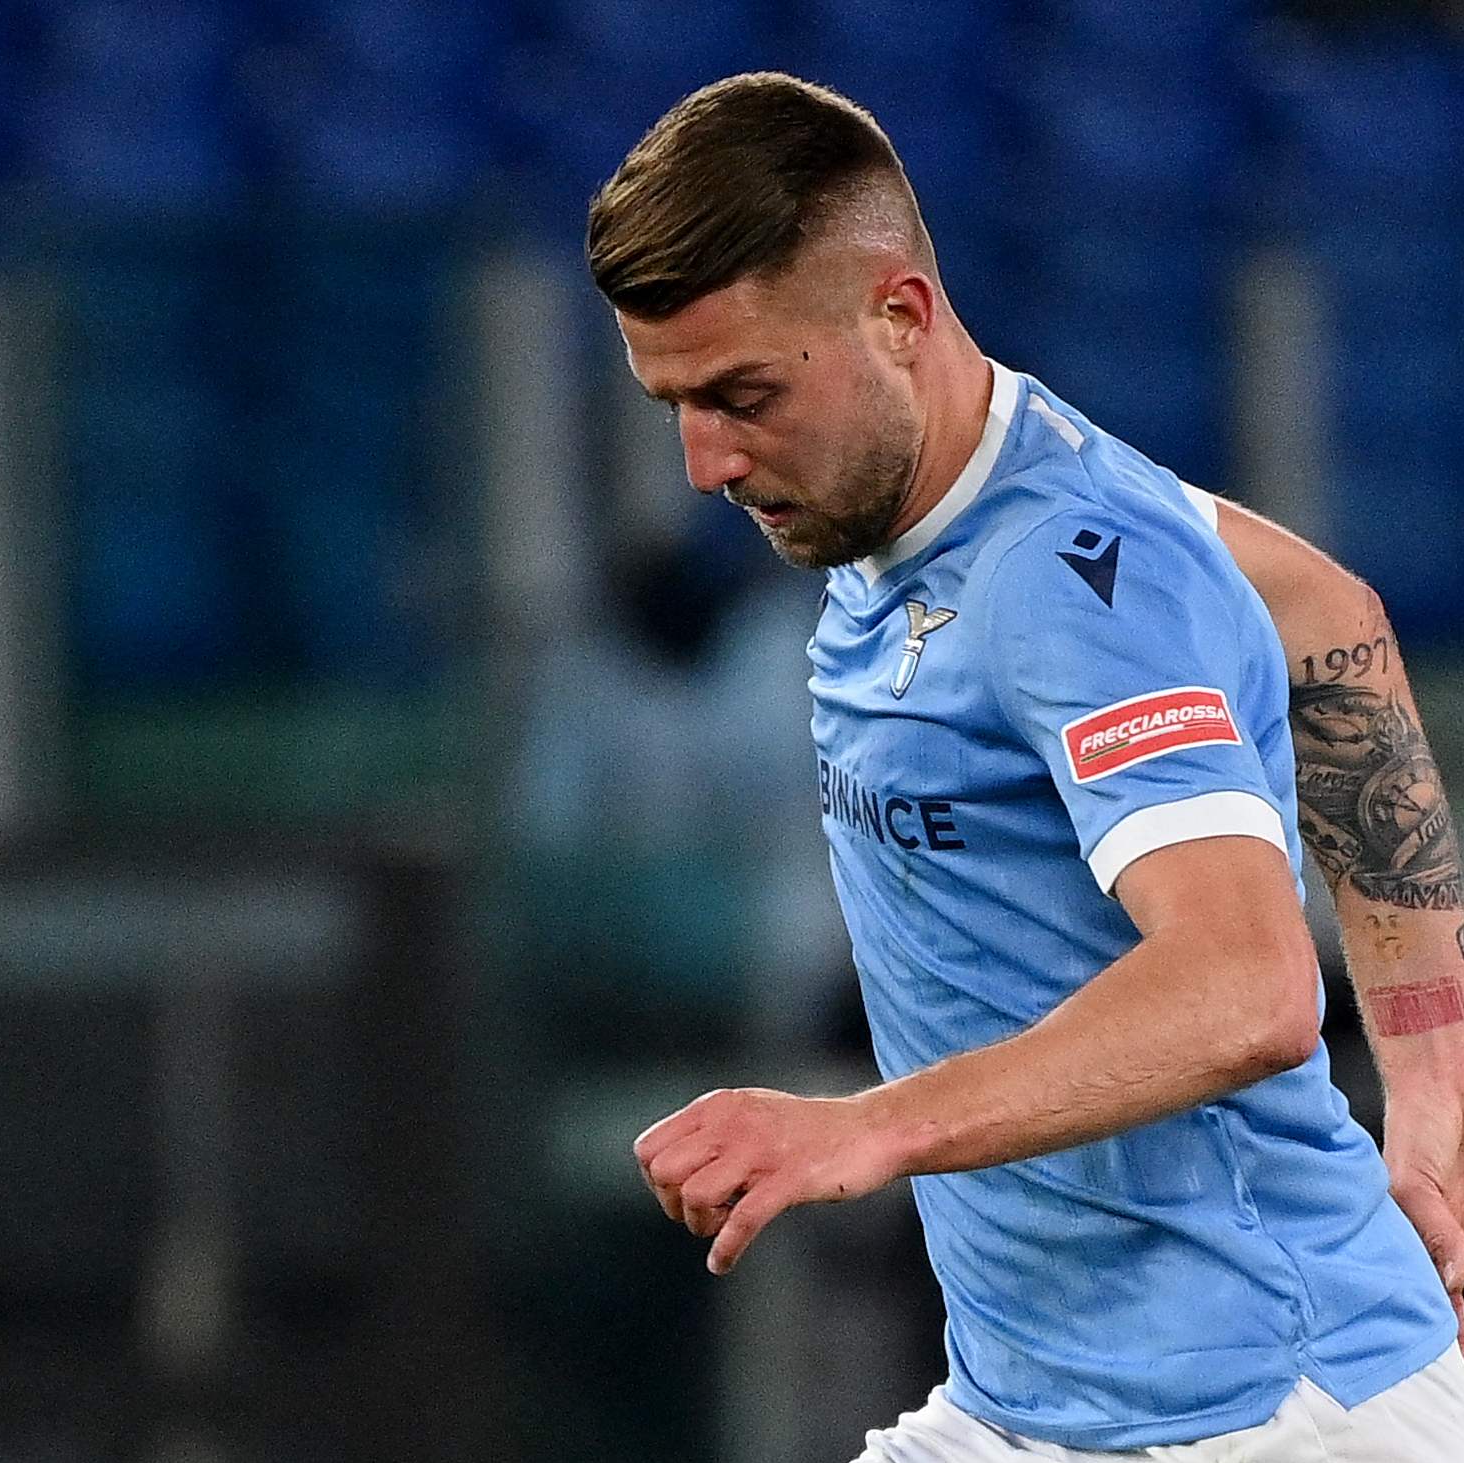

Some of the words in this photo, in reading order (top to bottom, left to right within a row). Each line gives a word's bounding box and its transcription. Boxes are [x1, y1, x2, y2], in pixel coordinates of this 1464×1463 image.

[1300, 637, 1388, 685] 1997
[1079, 705, 1227, 755] FRECCIAROSSA
[820, 758, 966, 851] BINANCE
